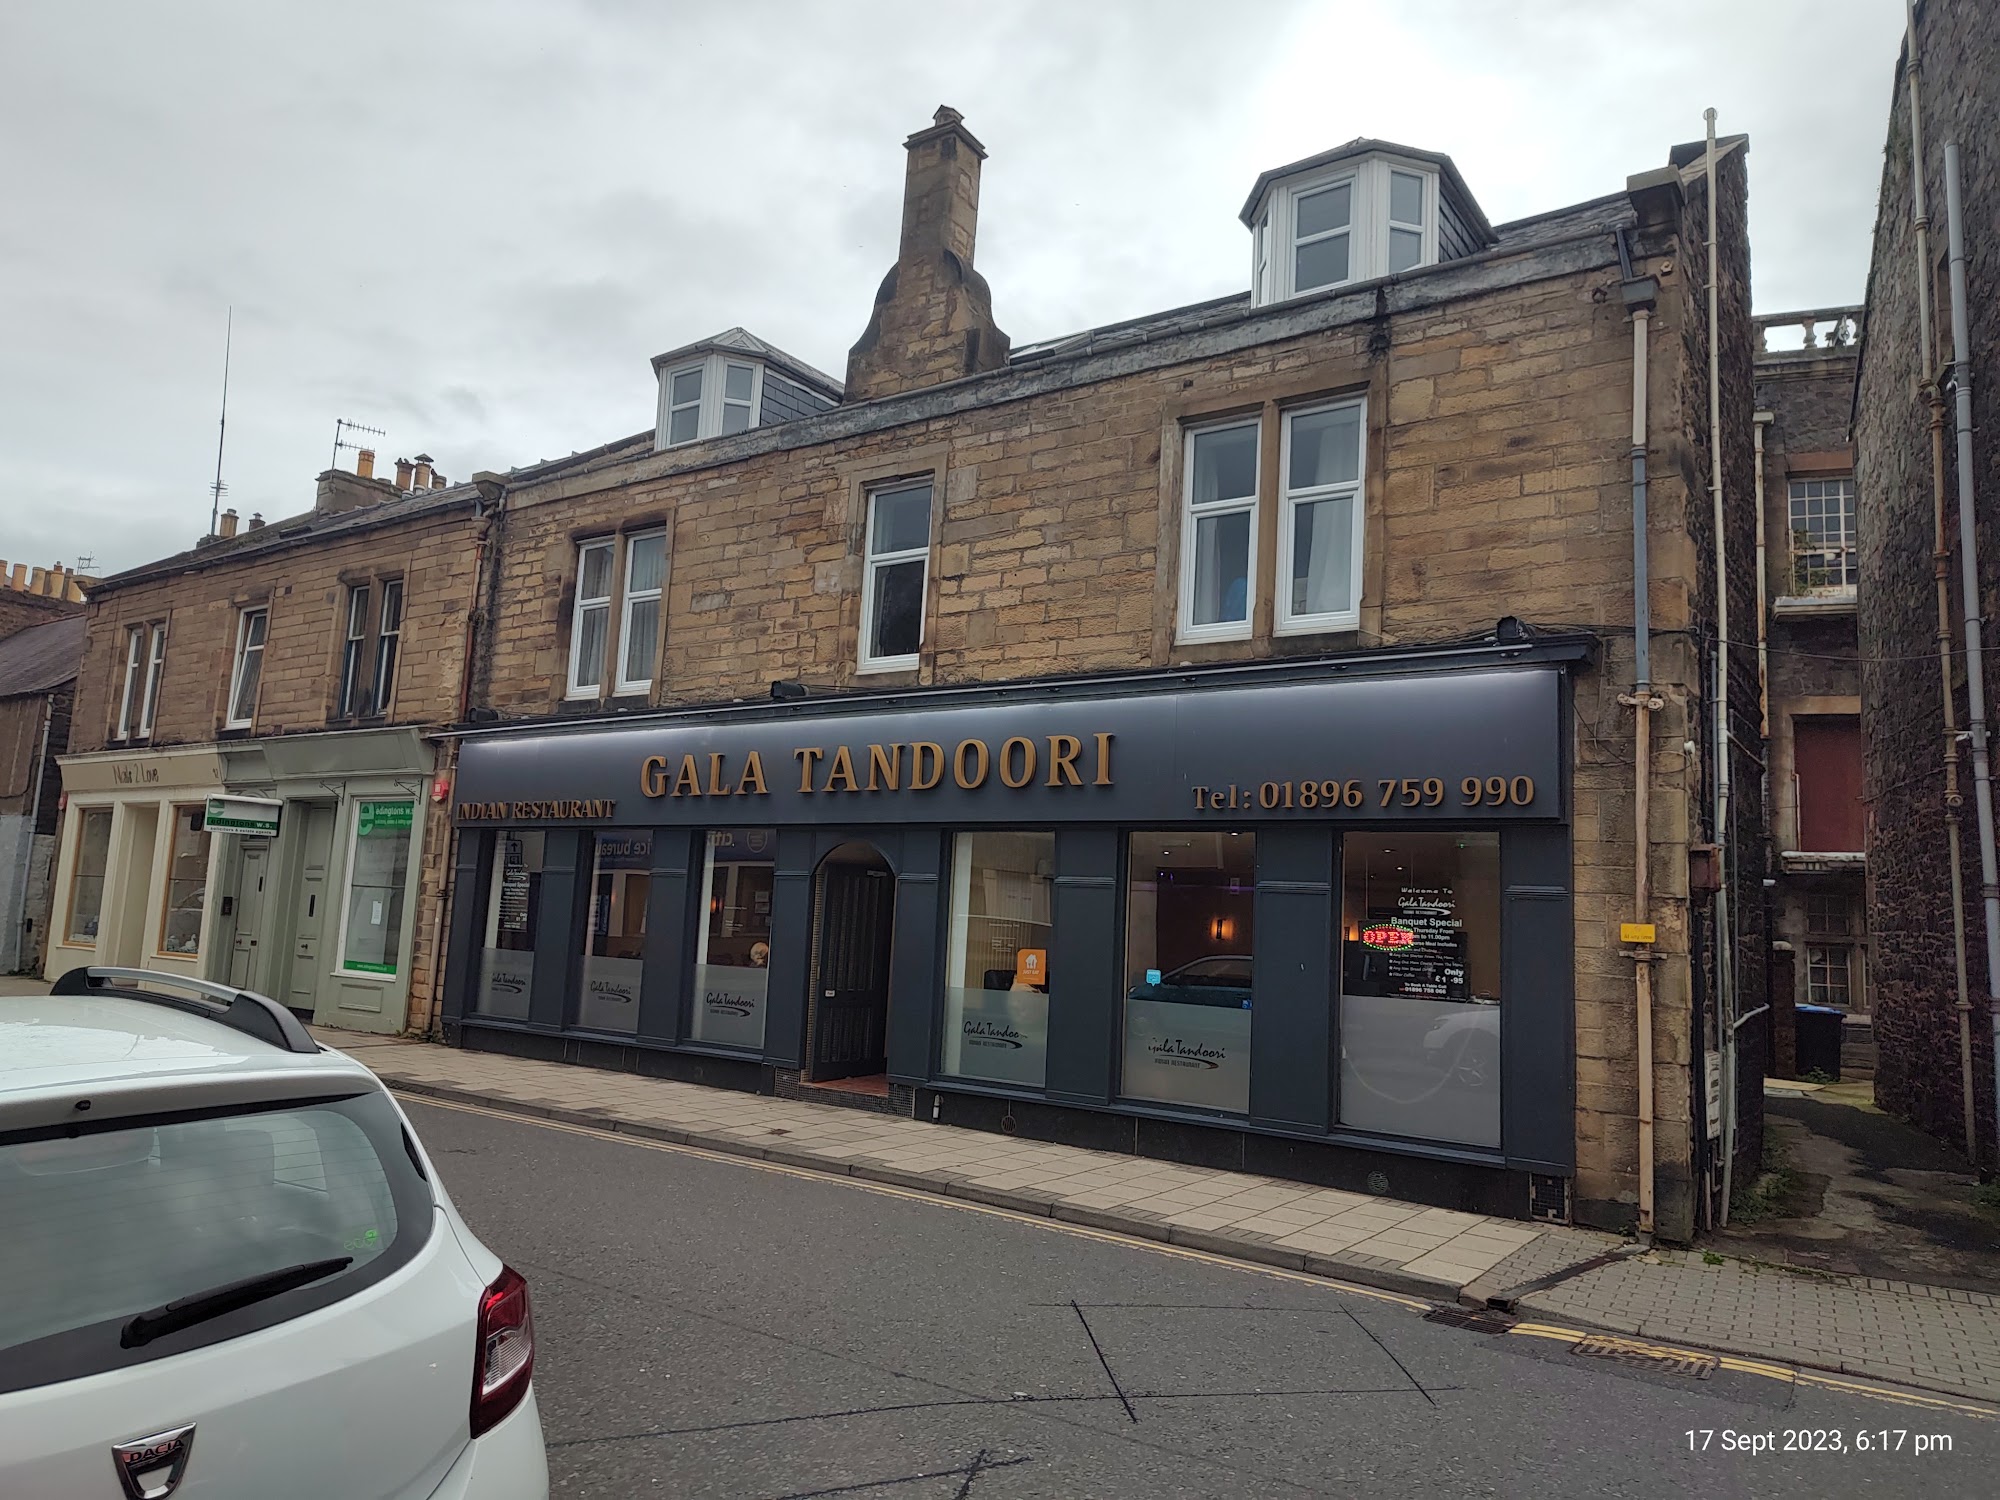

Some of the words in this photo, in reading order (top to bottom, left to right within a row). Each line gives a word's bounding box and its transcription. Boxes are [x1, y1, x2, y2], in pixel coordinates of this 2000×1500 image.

[640, 750, 770, 798] GALA
[793, 732, 1115, 793] TANDOORI
[1191, 784, 1252, 810] Tel:
[1259, 779, 1364, 809] 01896
[1377, 777, 1445, 807] 759
[1460, 775, 1535, 807] 990
[375, 806, 404, 816] edingtons
[456, 801, 509, 820] INDIAN
[512, 799, 616, 819] RESTAURANT
[211, 819, 255, 828] edingtons
[1398, 896, 1418, 908] Gala
[1418, 897, 1456, 908] Tandoori
[1391, 916, 1428, 926] Banquet
[1429, 918, 1463, 928] Special
[1363, 930, 1413, 945] OPEN
[1413, 927, 1439, 935] Thursday
[1444, 968, 1464, 977] Only
[590, 981, 604, 993] Gala
[605, 981, 632, 995] Tandoori
[706, 992, 723, 1006] Gala
[723, 993, 755, 1008] Tandoori
[963, 1021, 986, 1036] Gala
[1175, 1039, 1226, 1059] Tandoori
[130, 1439, 184, 1463] DACIA
